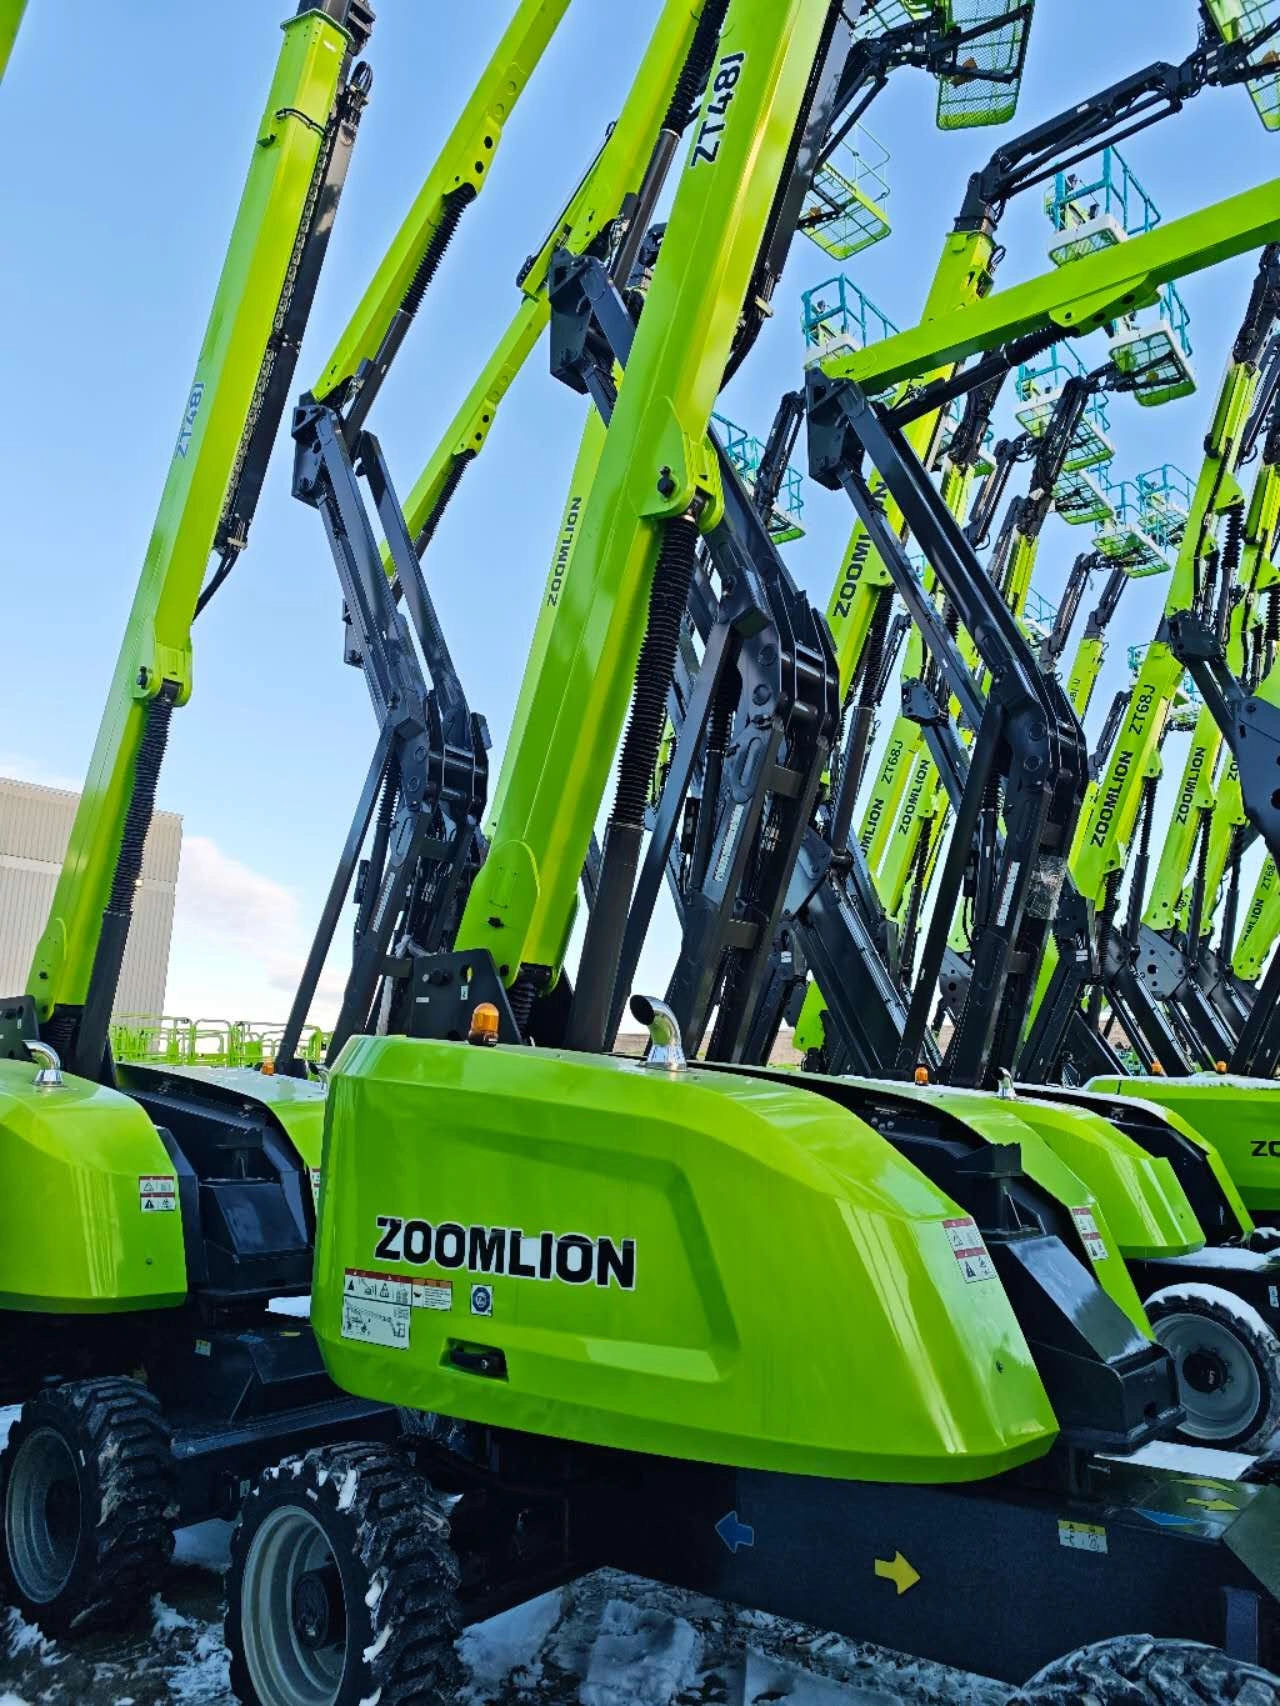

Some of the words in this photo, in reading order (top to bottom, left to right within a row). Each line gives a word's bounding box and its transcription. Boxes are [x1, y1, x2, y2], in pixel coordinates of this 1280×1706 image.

[689, 51, 745, 168] ZT48J
[547, 496, 582, 607] ZOOMLION
[881, 739, 904, 785] ZT68J
[899, 759, 931, 835] ZOOMLION
[1090, 750, 1134, 848] ZOOMLION
[1128, 684, 1156, 736] ZT68J
[1176, 746, 1207, 825] ZOOMLION
[374, 1215, 637, 1290] ZOOMLION
